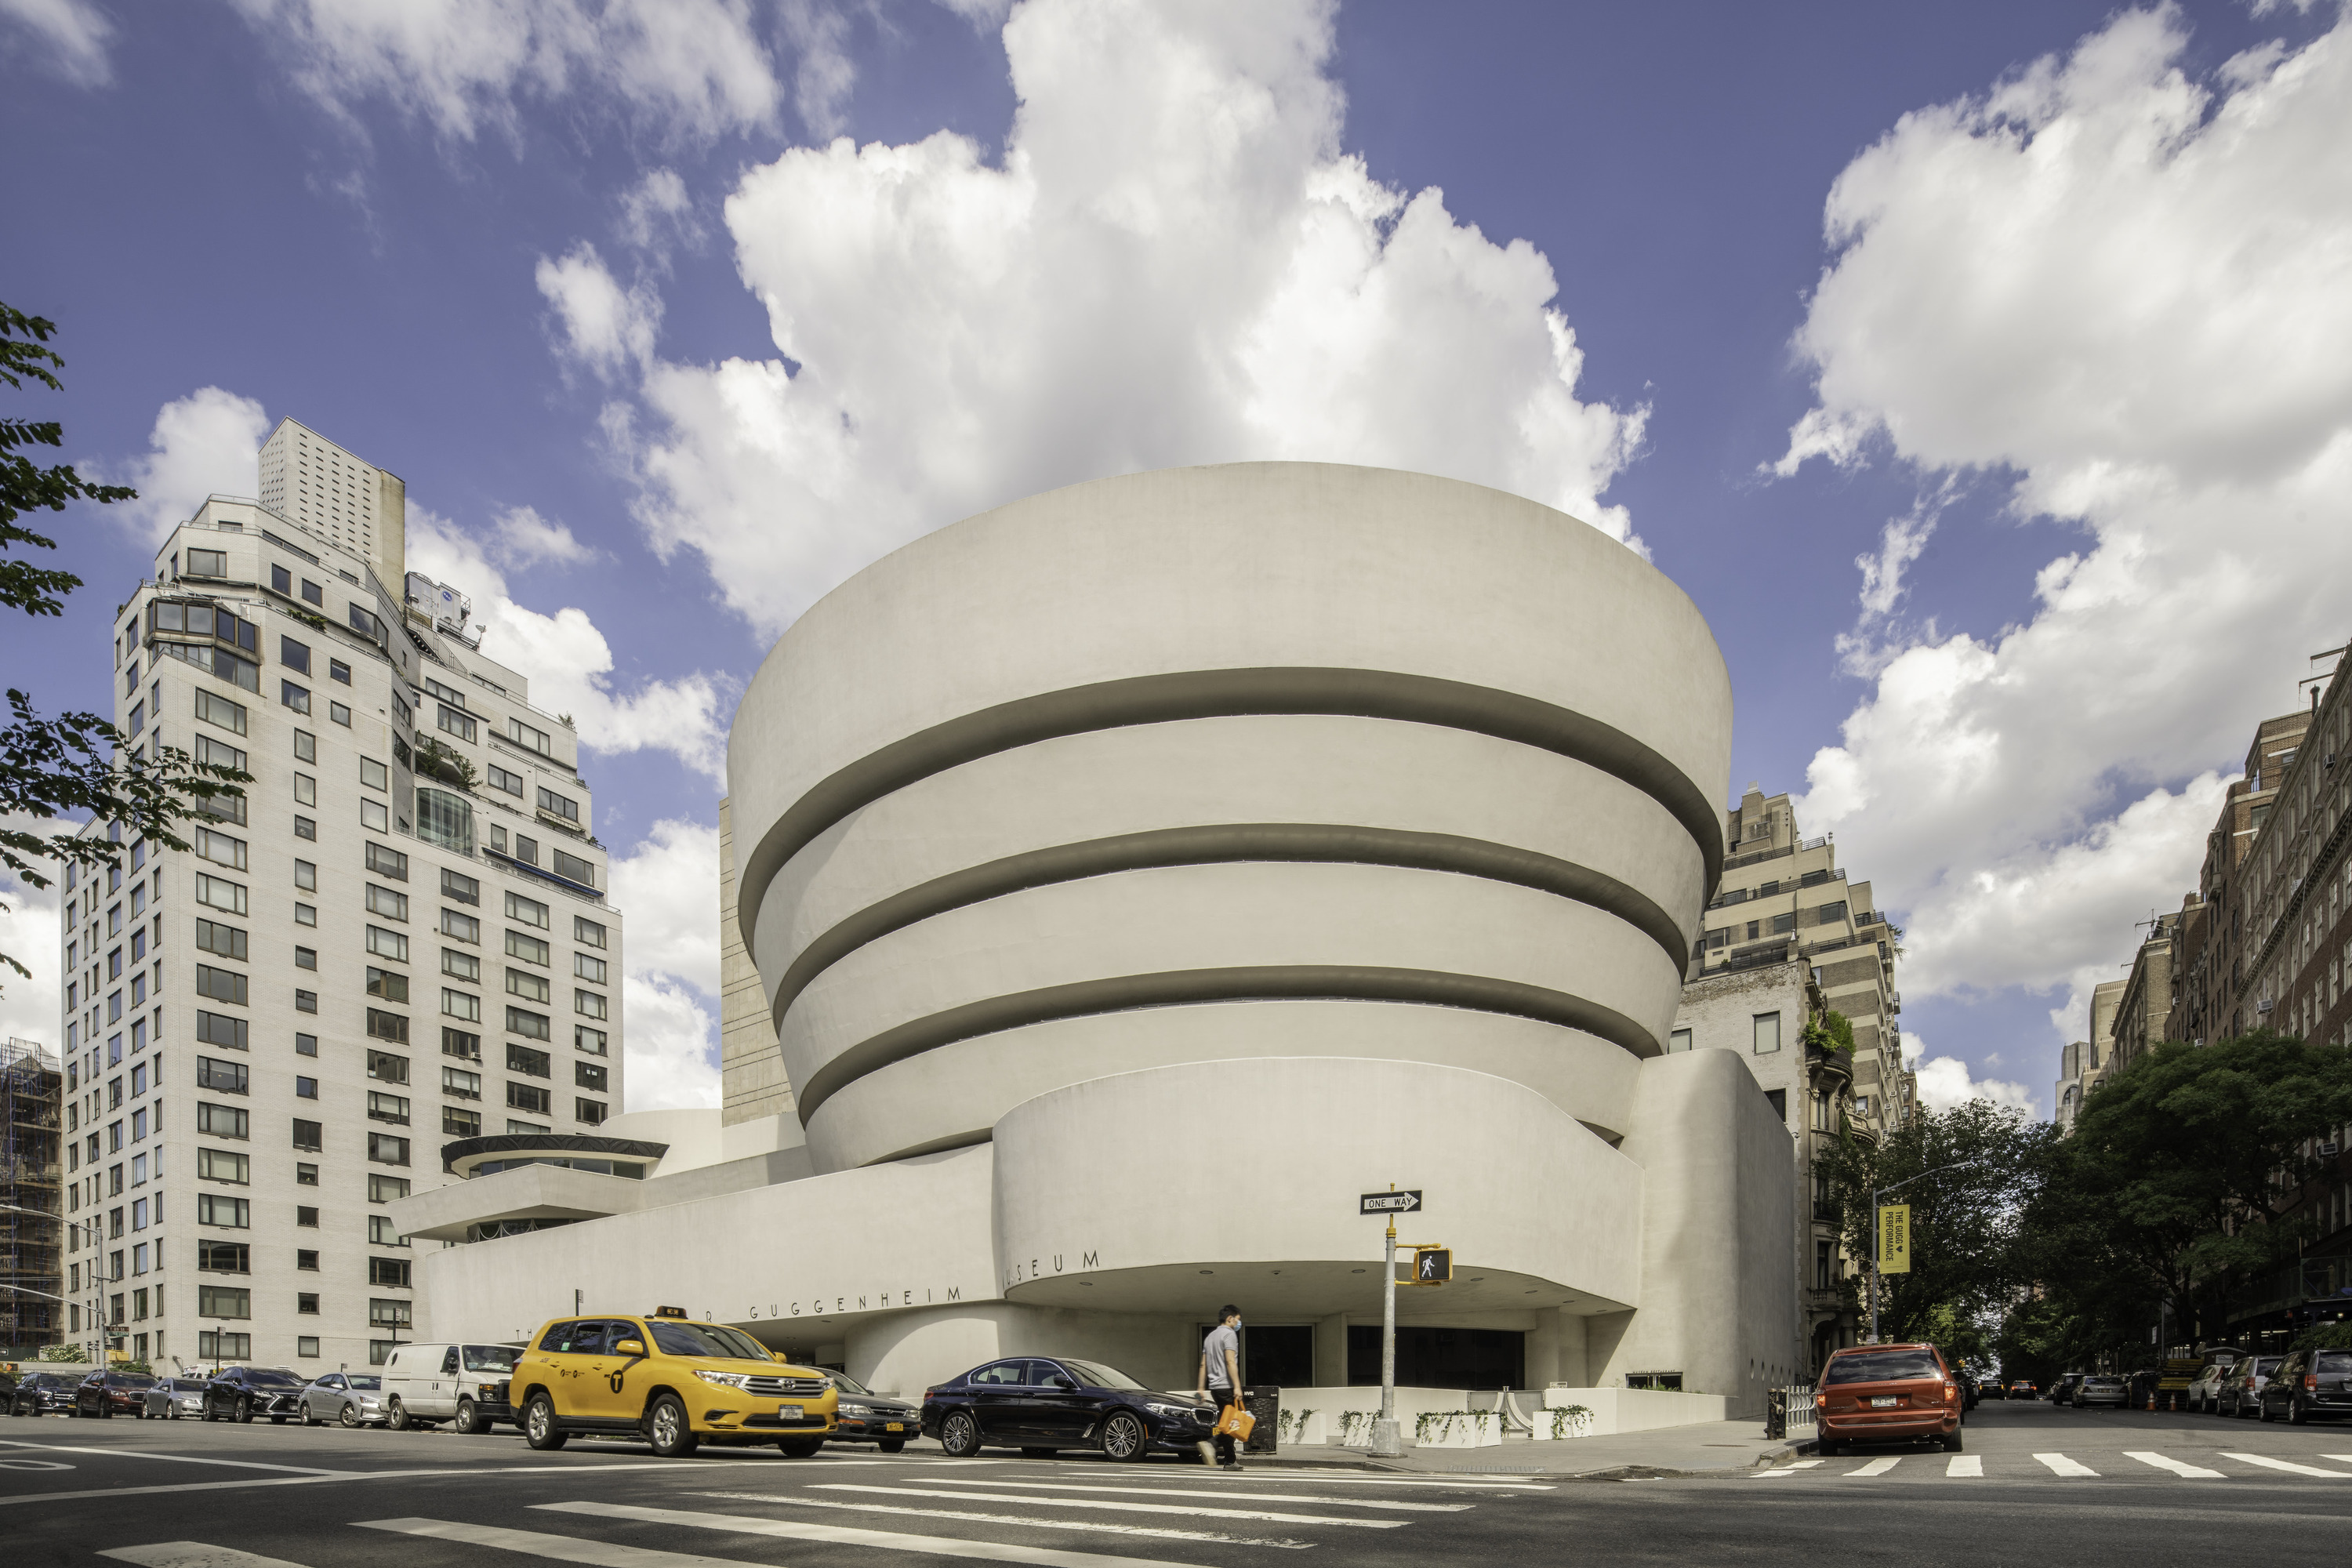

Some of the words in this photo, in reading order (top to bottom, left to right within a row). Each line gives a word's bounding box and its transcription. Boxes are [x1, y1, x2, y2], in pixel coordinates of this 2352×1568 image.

[1369, 1199, 1386, 1208] ONE
[1394, 1197, 1413, 1207] WAY
[750, 1286, 961, 1319] GUGGENHEIM
[1002, 1250, 1099, 1291] USEUM
